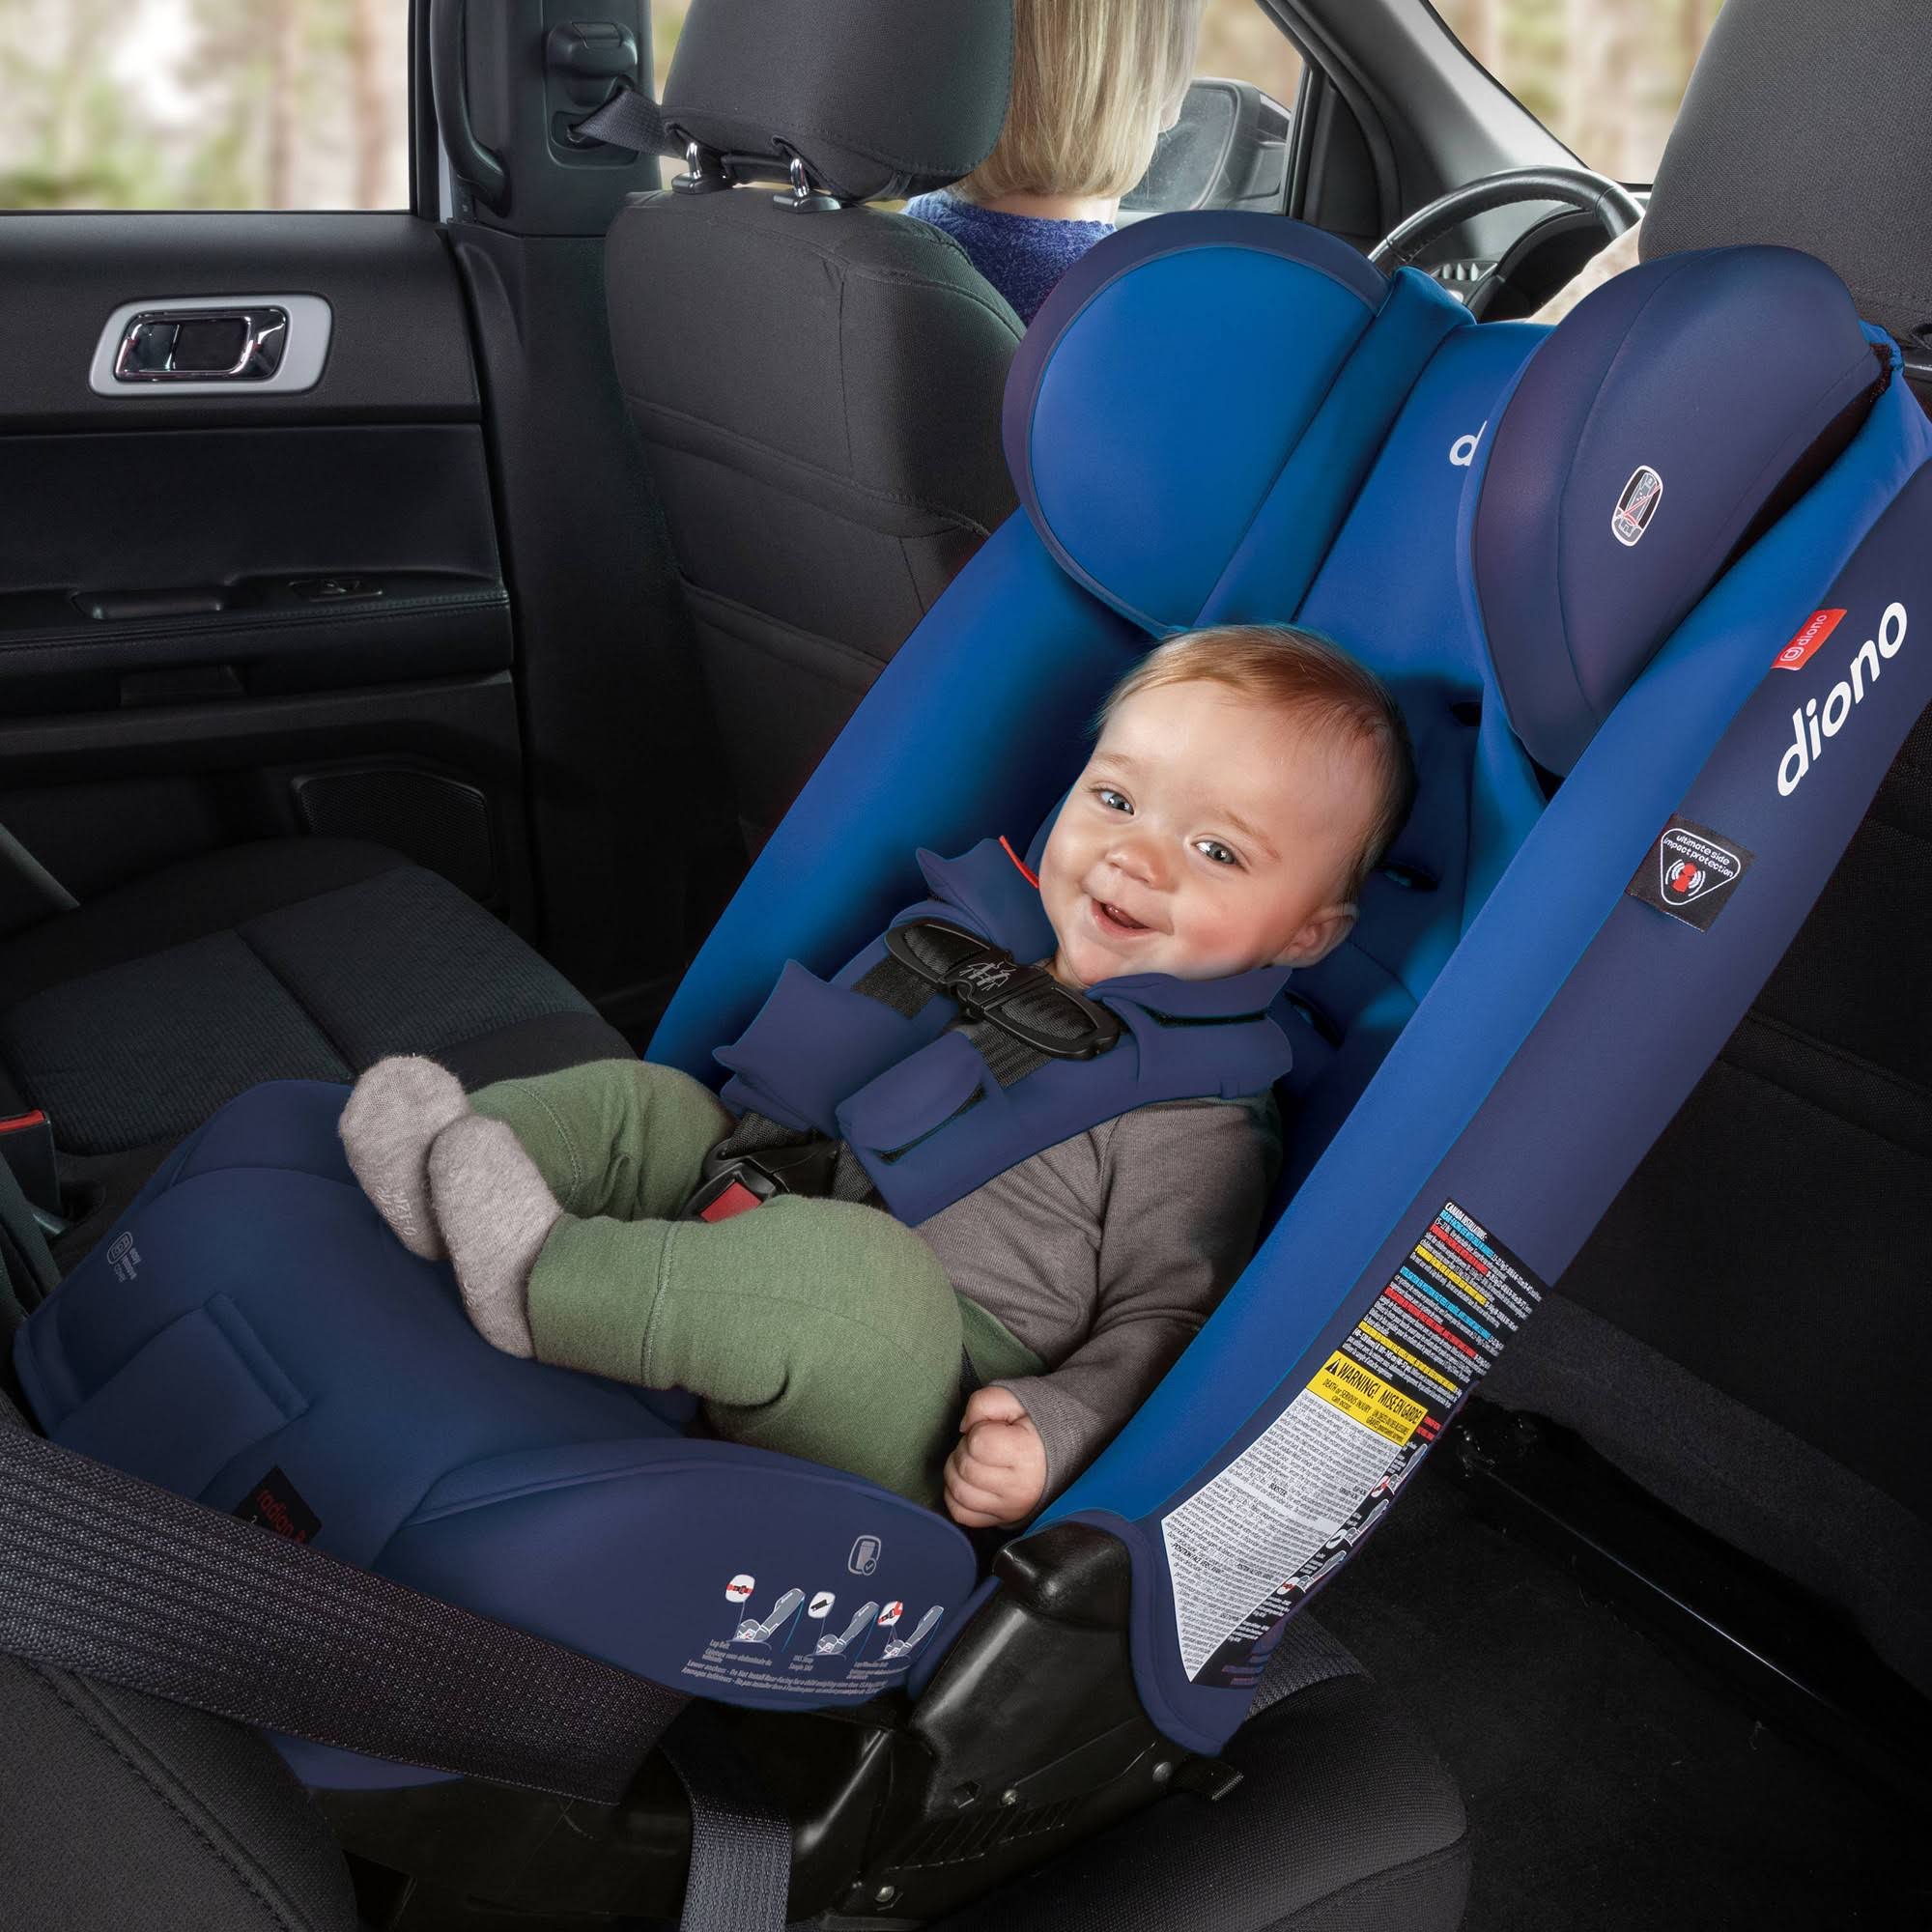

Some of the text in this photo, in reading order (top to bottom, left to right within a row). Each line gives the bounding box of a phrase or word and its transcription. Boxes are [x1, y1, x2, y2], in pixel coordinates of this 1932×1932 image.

[1797, 614, 1828, 646] diono
[1777, 602, 1908, 797] diono
[1662, 837, 1734, 877] impact protection
[1675, 834, 1730, 866] ultimate side
[1321, 1378, 1338, 1392] DEATH
[1336, 1361, 1381, 1399] WARNING!
[1377, 1387, 1400, 1410] MISE
[1392, 1397, 1406, 1414] EN
